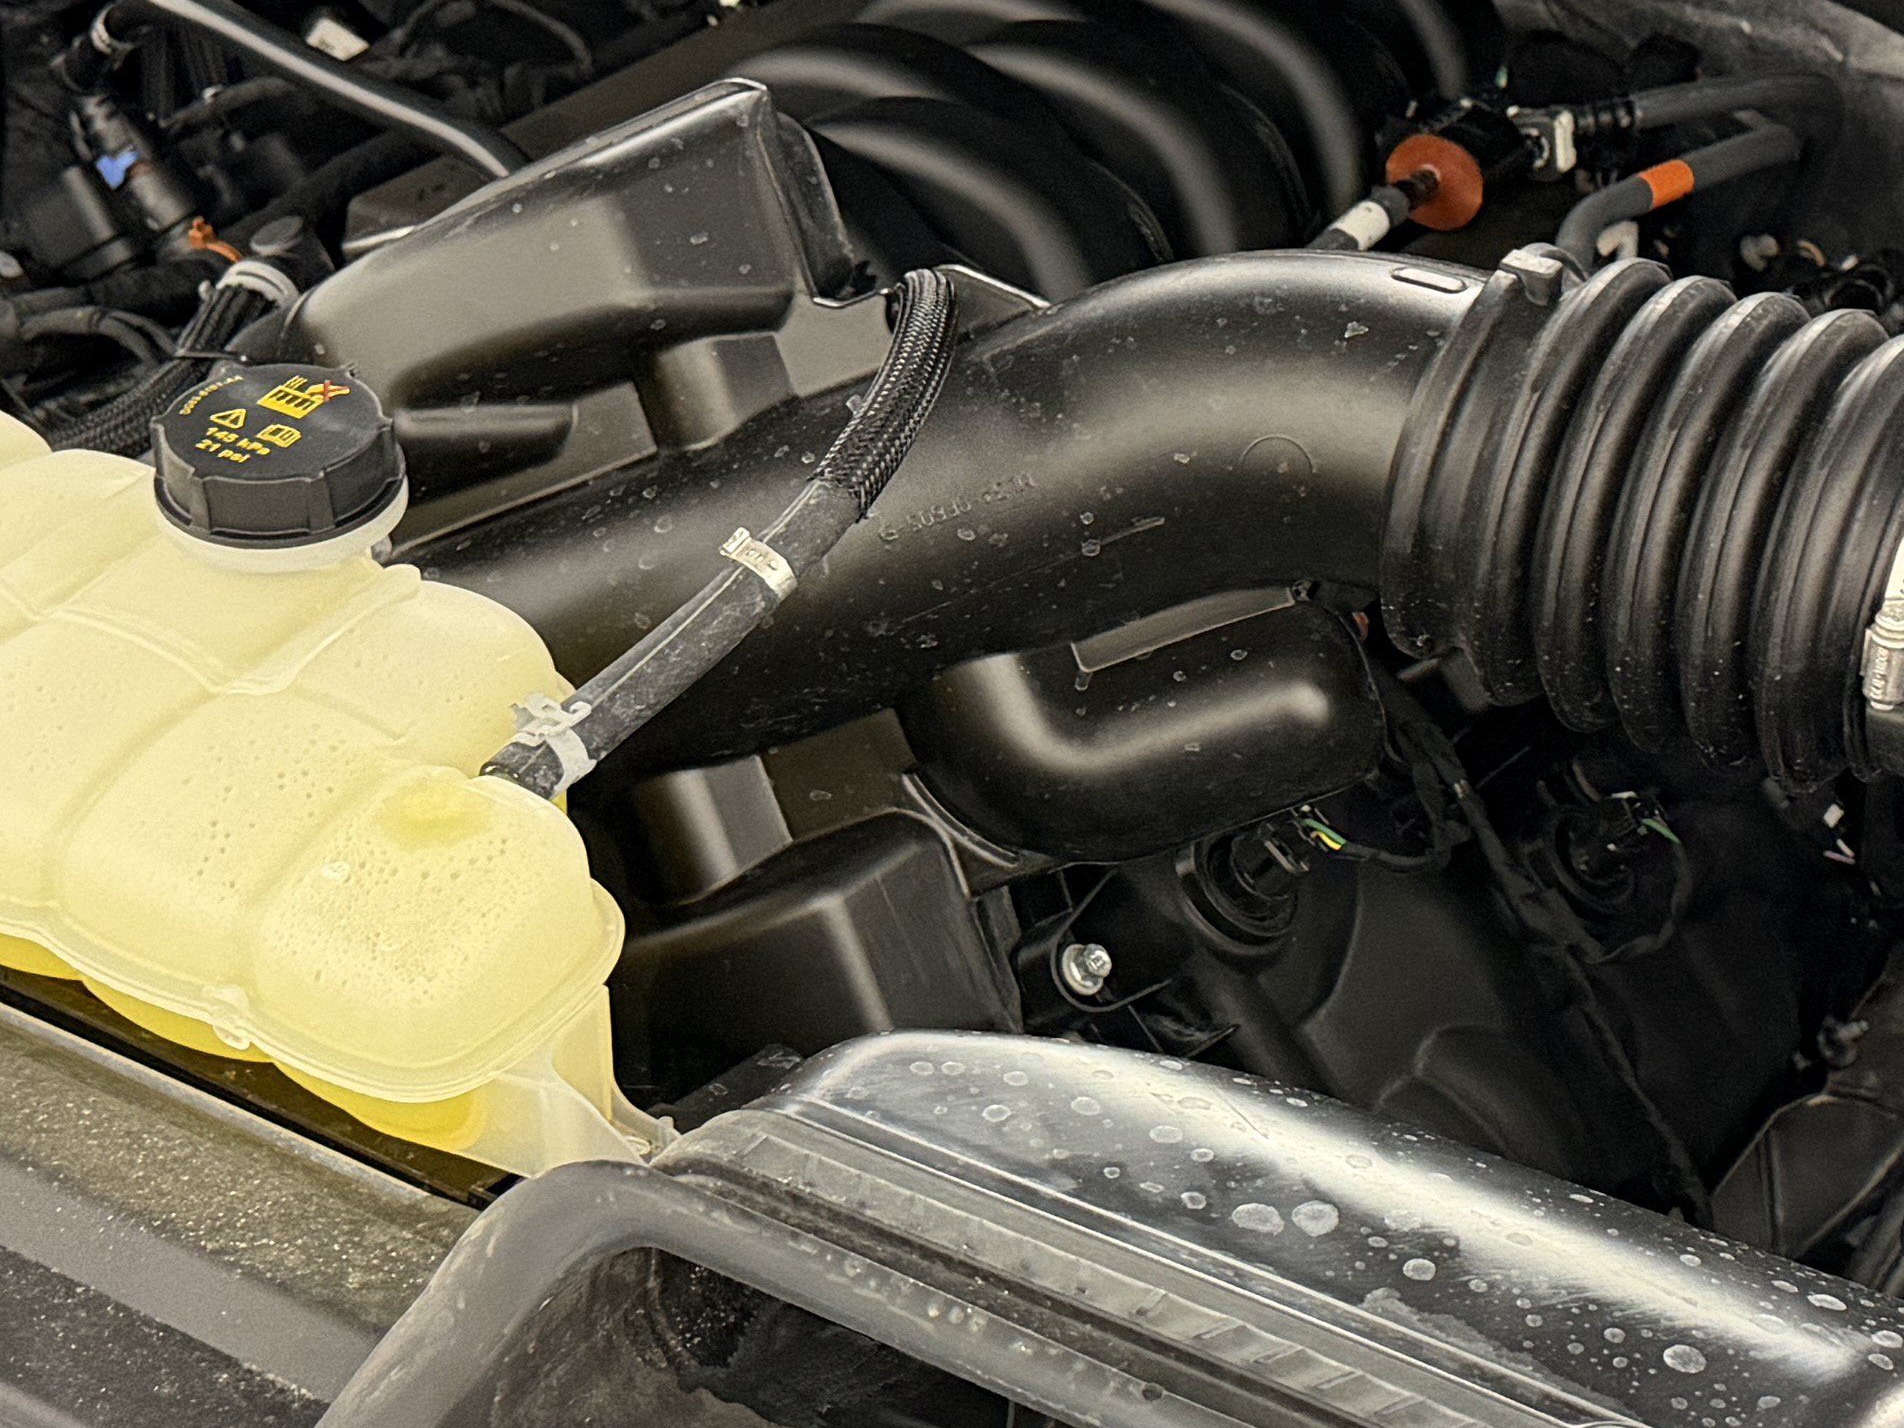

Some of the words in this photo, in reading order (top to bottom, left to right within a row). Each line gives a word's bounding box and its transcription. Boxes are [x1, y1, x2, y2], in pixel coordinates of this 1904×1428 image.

[206, 427, 240, 444] 145
[195, 439, 223, 453] 21
[217, 449, 252, 464] psi
